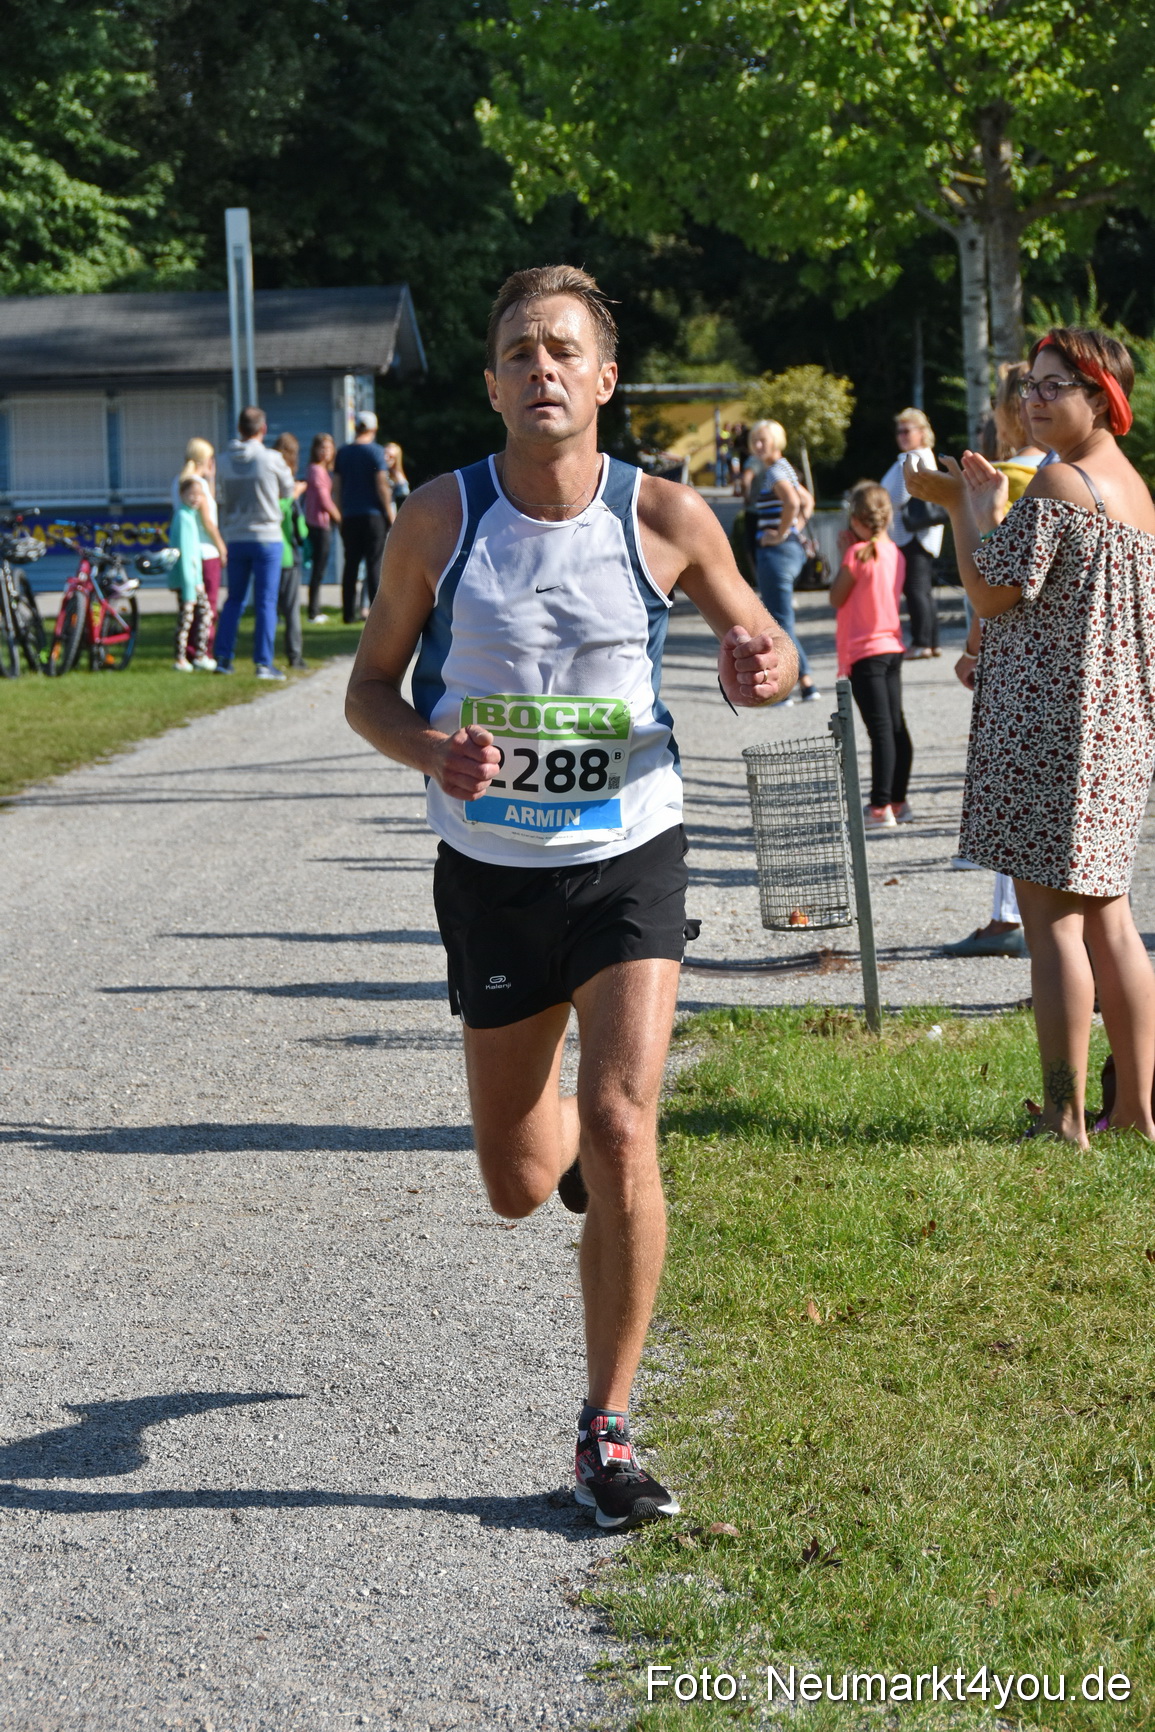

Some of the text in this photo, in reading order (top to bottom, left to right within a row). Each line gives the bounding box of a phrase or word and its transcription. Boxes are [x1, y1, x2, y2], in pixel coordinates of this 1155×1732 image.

[473, 699, 617, 735] BOCK
[613, 751, 622, 760] B
[504, 805, 581, 828] ARMIN
